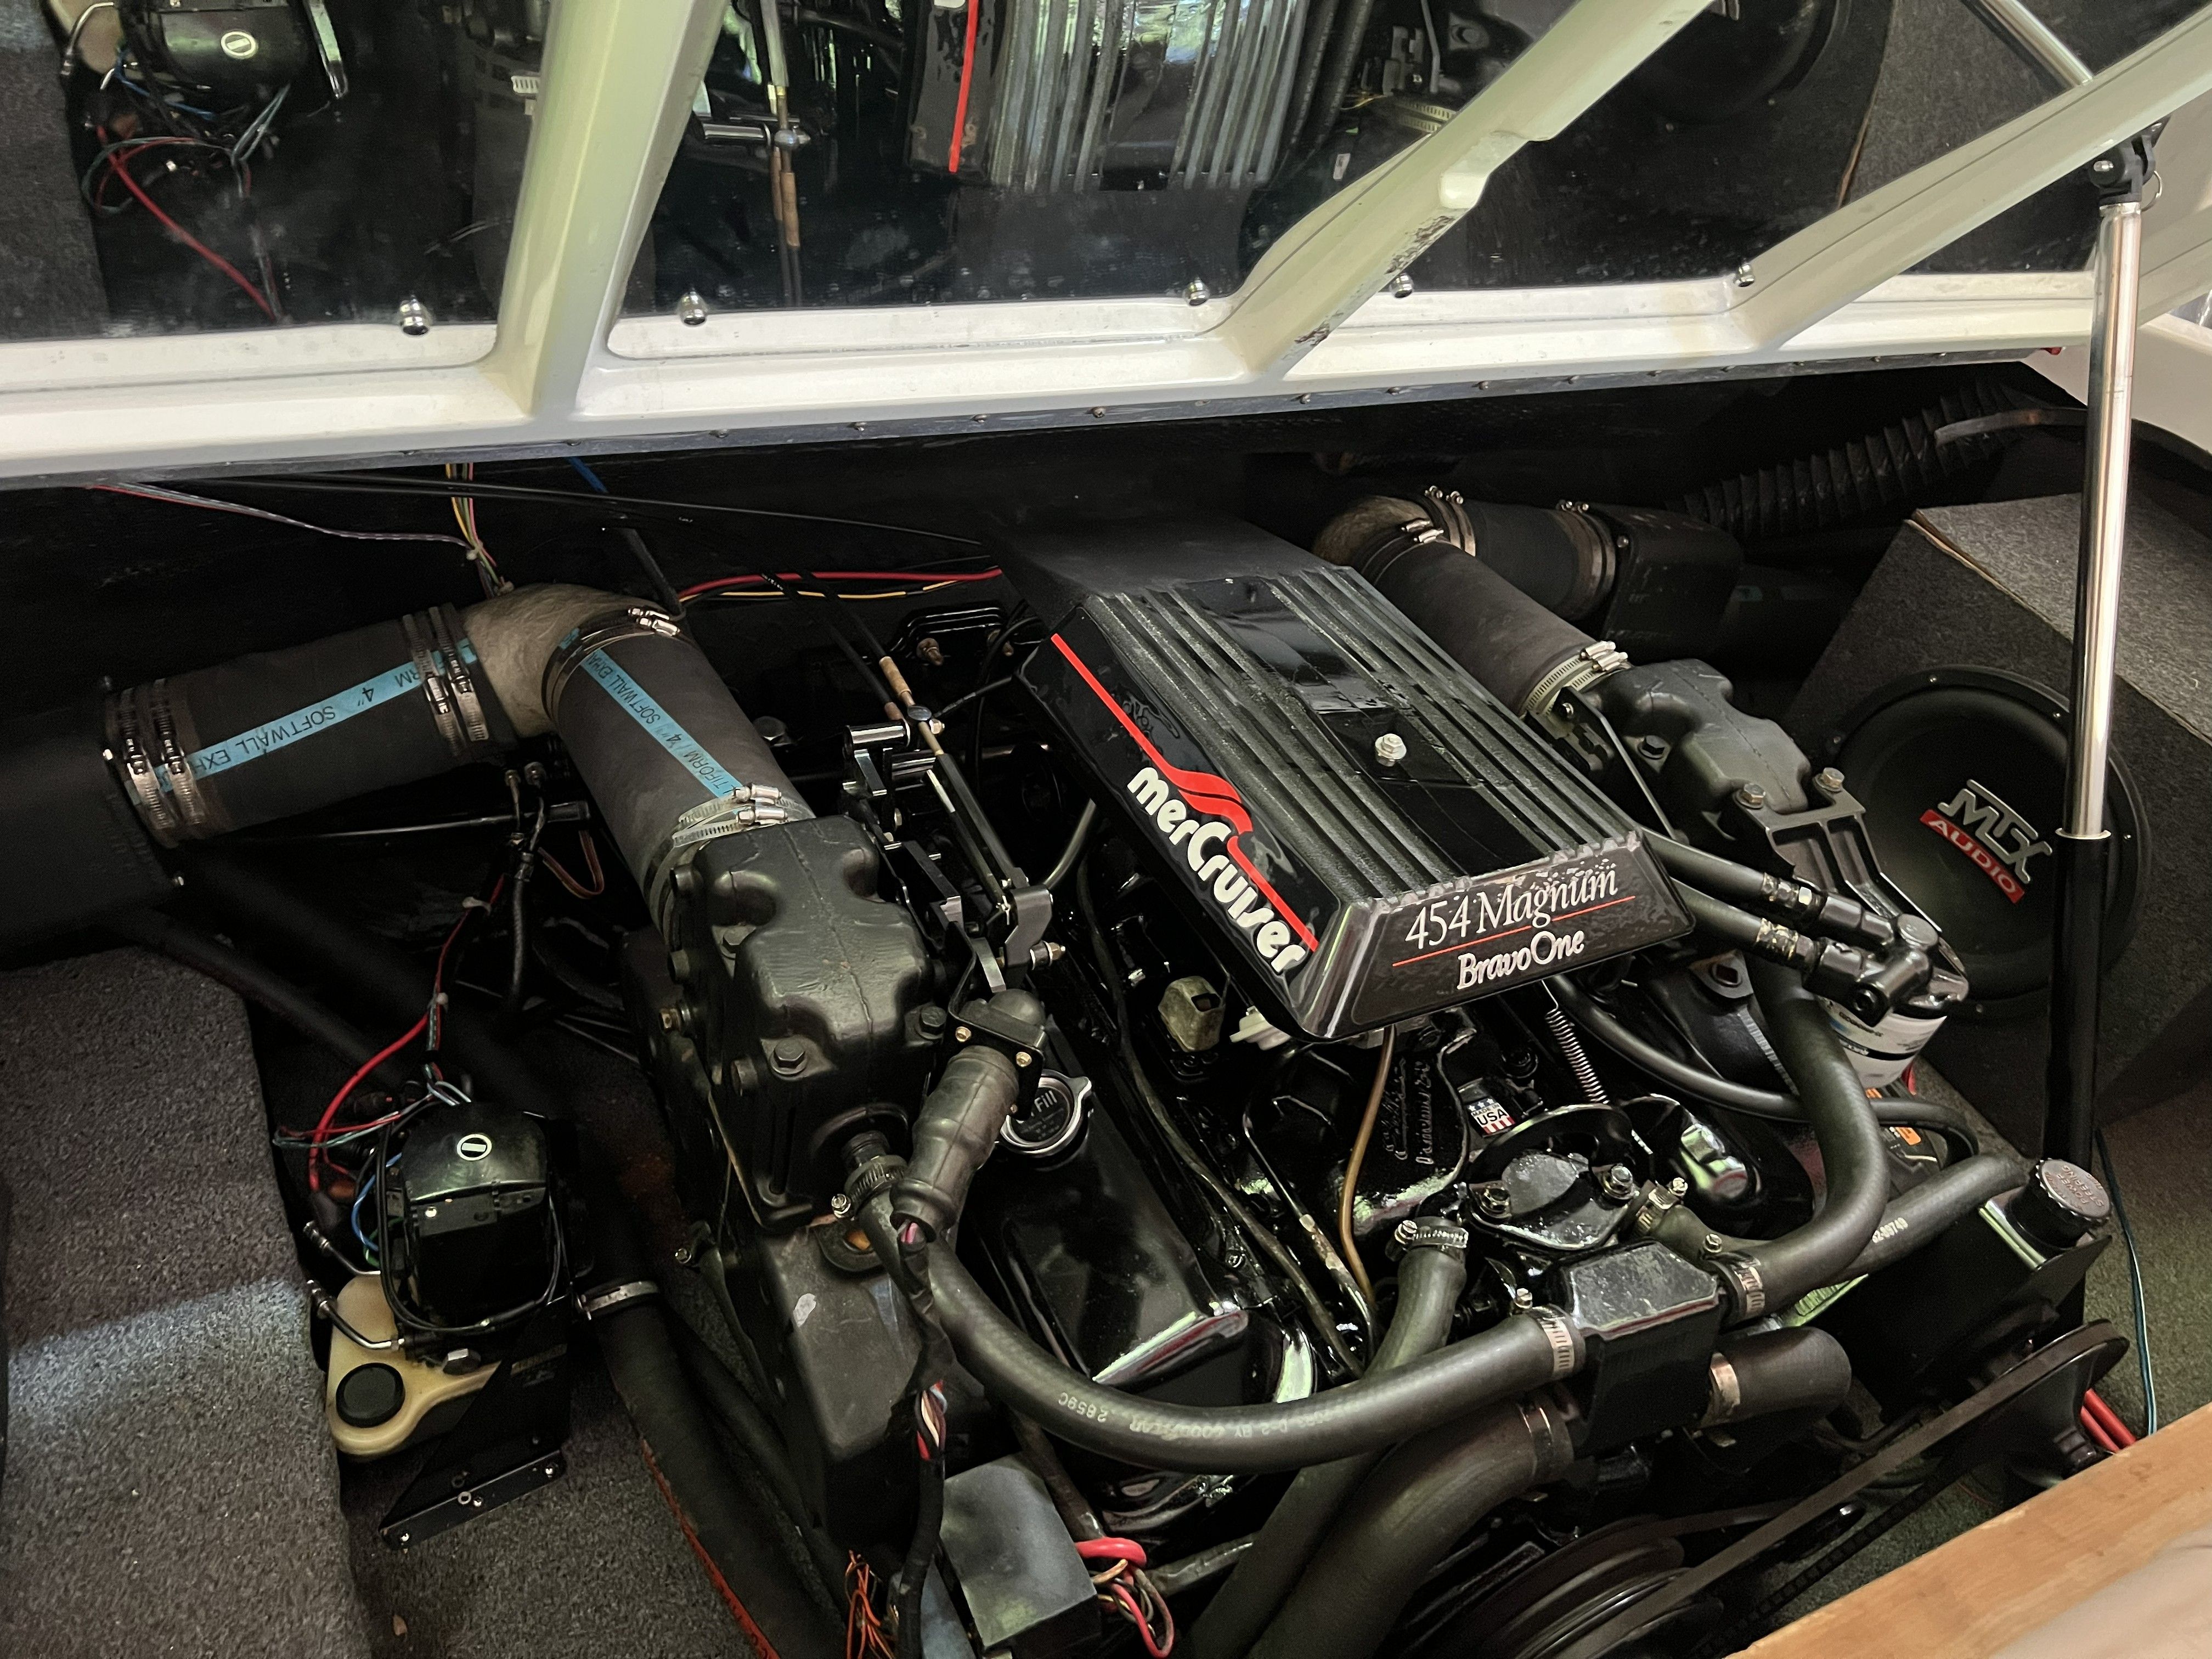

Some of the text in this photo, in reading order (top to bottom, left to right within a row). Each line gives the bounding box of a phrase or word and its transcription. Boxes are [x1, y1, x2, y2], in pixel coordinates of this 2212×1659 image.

[609, 674, 661, 725] SOFTWALL
[234, 707, 336, 755] SOFTWALL
[1937, 778, 2053, 884] MTX
[1928, 820, 2016, 893] AUDIO
[1404, 869, 1618, 950] 454 Magnum
[1034, 1090, 1058, 1113] Fill
[1476, 1108, 1507, 1125] USA
[2061, 1165, 2104, 1207] STEERING
